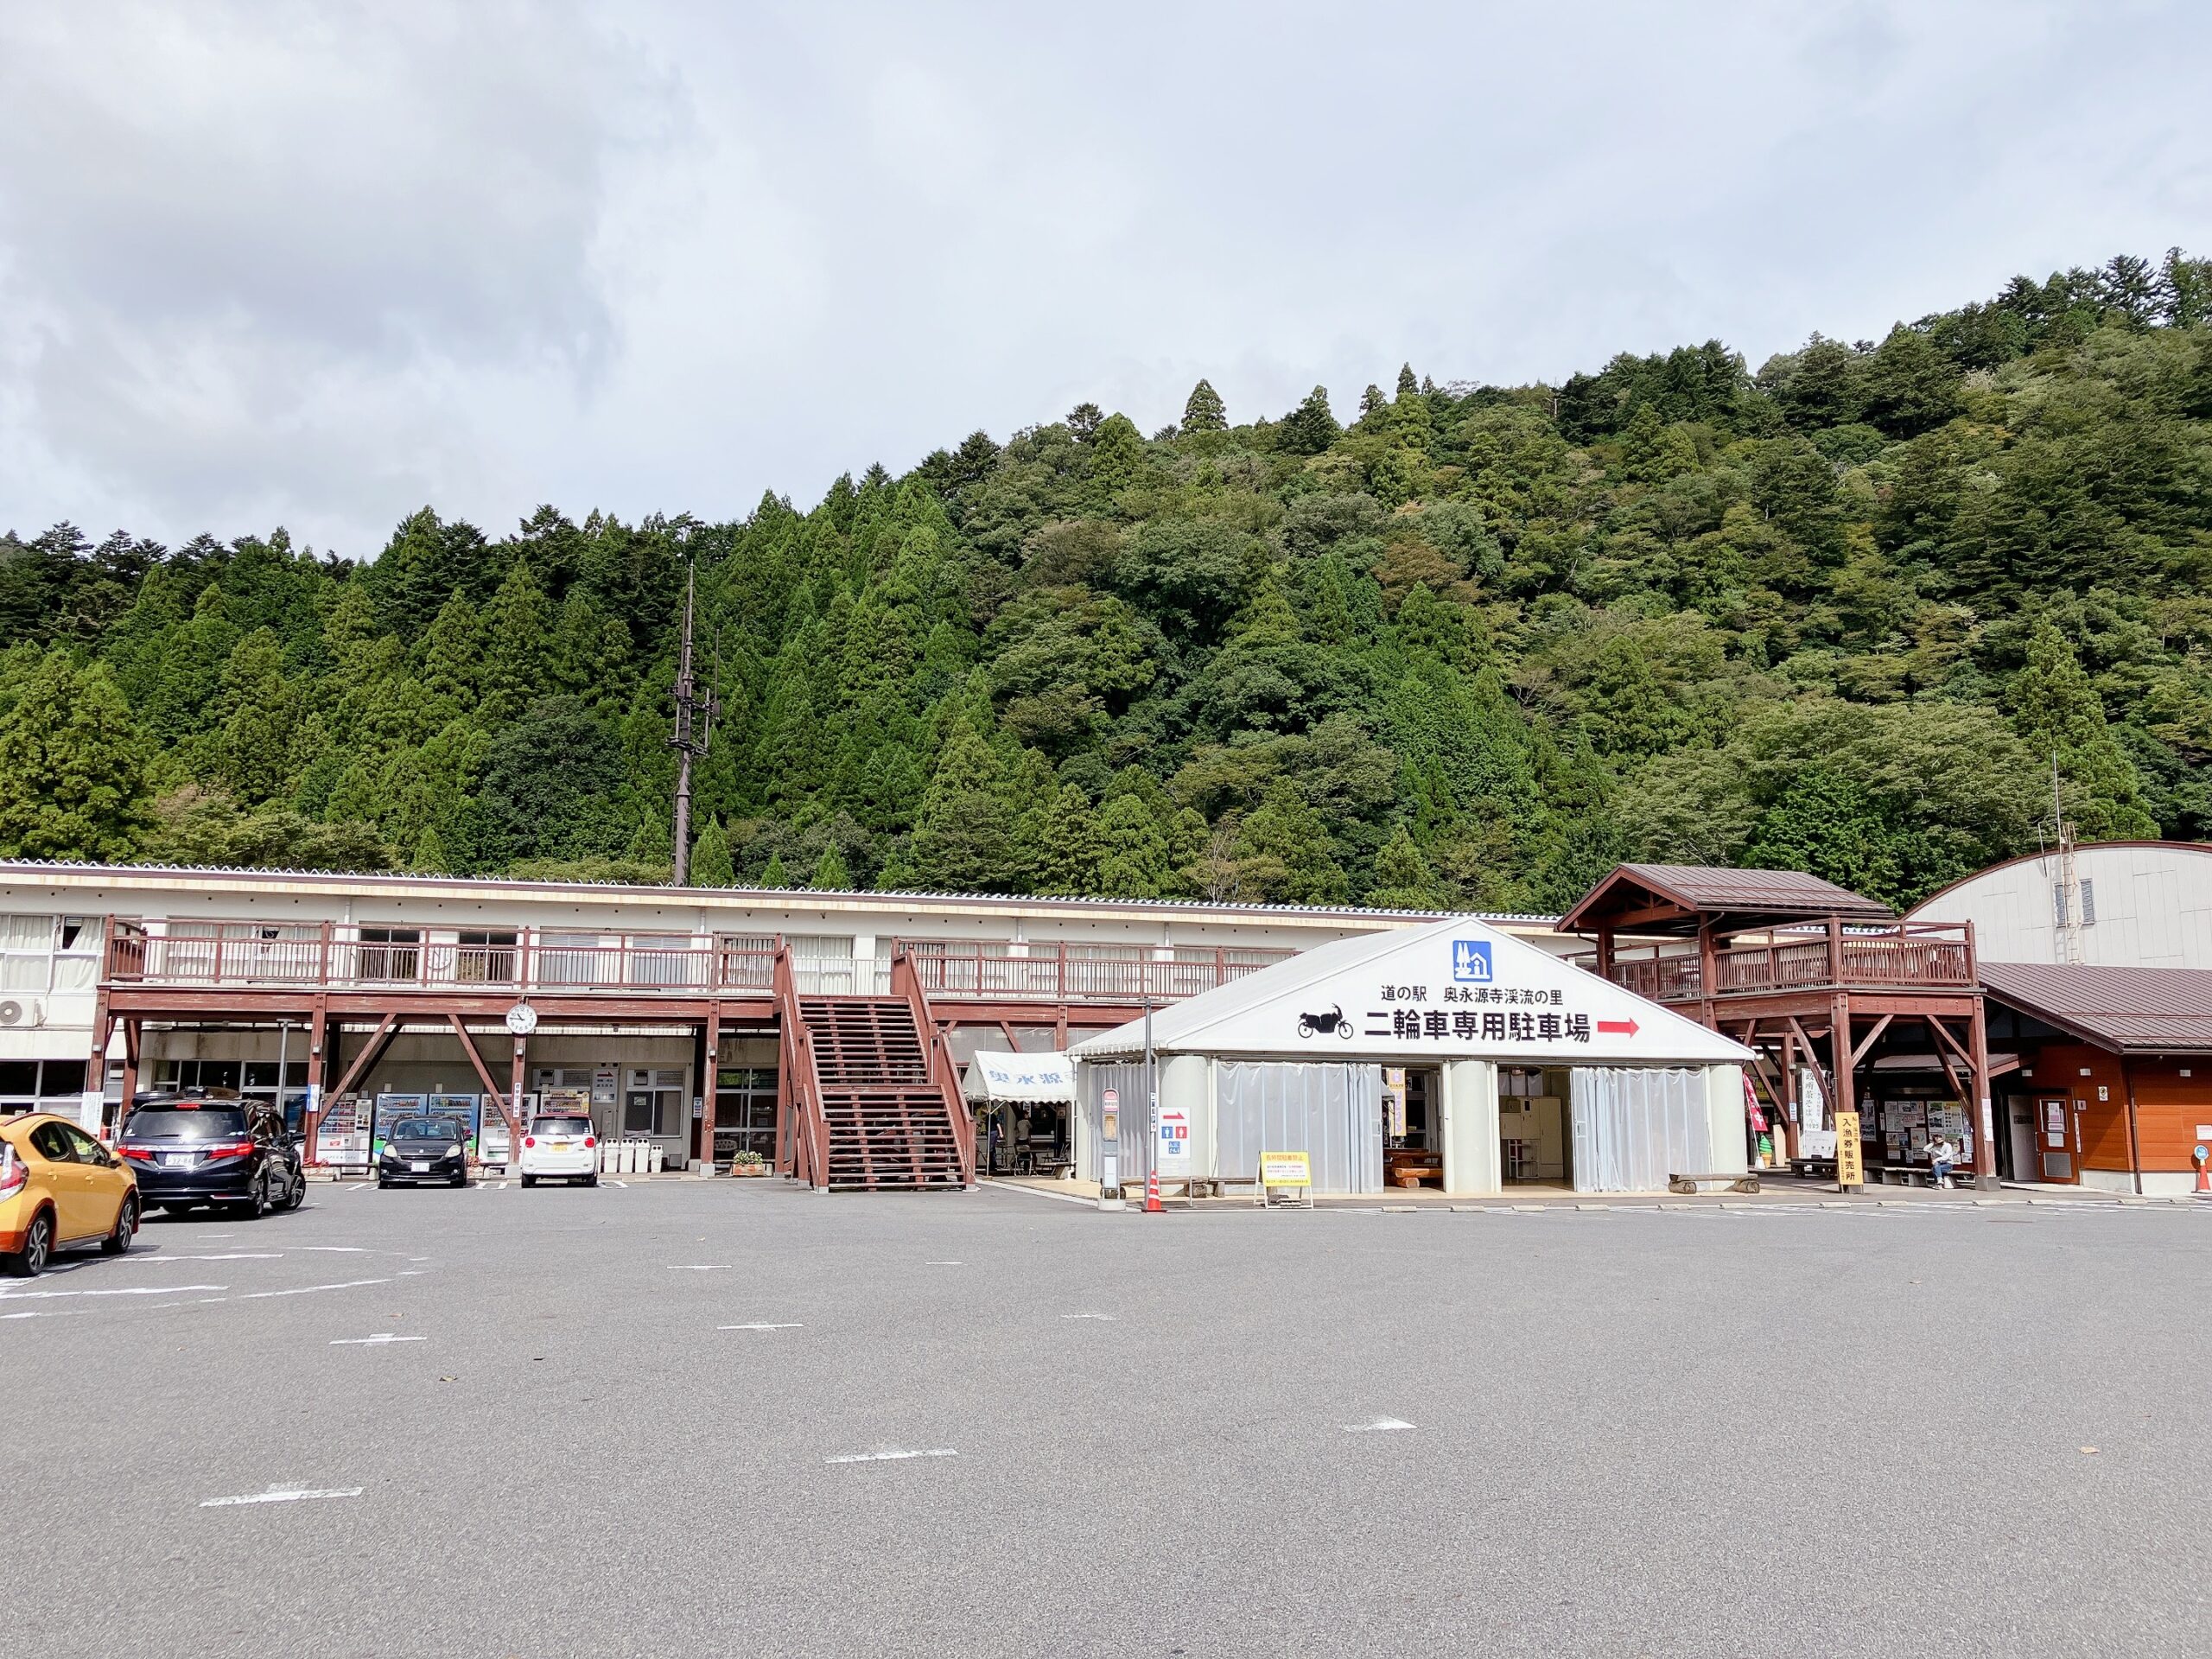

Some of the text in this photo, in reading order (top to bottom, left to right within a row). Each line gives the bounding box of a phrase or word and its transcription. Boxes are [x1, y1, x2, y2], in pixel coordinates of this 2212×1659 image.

[1381, 985, 1564, 1006] 道の駅 奥永源寺渓流の里
[1364, 1008, 1591, 1043] 二輪車専用駐車場
[1842, 1118, 1855, 1180] 入漁券販売所
